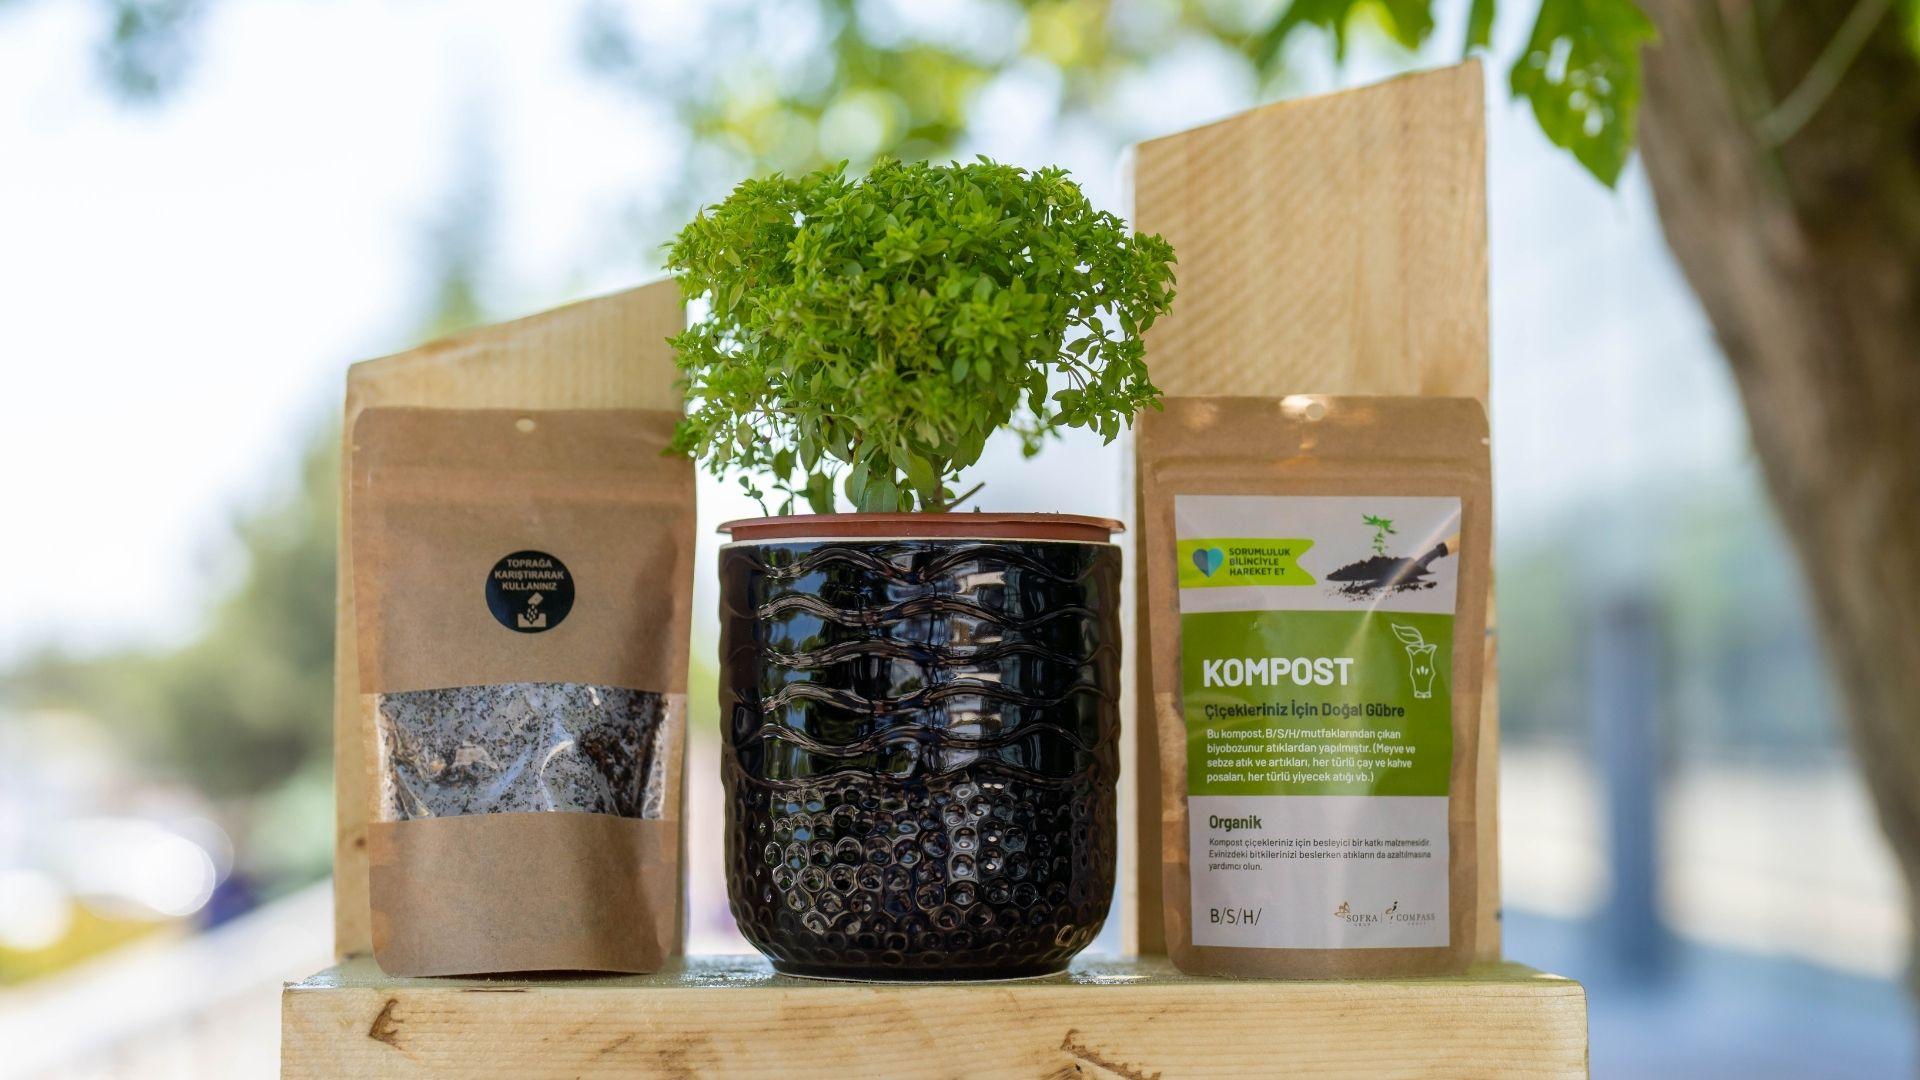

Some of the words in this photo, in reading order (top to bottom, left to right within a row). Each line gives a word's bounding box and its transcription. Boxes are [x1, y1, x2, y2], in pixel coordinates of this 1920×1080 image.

[1229, 548, 1290, 556] SORUMLULUK
[507, 558, 552, 568] TOPRAĞA
[1230, 556, 1279, 566] BİLİNCİYLE
[495, 571, 564, 581] KARIŞTIRARAK
[1230, 568, 1272, 576] HAREKET
[502, 582, 557, 590] KULLANINIZ
[1203, 657, 1354, 687] KOMPOST
[1205, 702, 1288, 720] Çiçekleriniz
[1291, 699, 1318, 718] İçin
[1322, 703, 1362, 719] Doğal
[1366, 703, 1404, 717] Gübre
[1207, 729, 1219, 738] Bu
[1377, 730, 1400, 740] çıkan
[1207, 744, 1264, 755] biyobozunur
[1266, 743, 1316, 752] atıklardan
[1207, 758, 1234, 767] sebze
[1236, 758, 1253, 767] atık
[1269, 757, 1310, 768] artıkları,
[1313, 757, 1329, 766] her
[1332, 757, 1354, 766] türlü
[1357, 759, 1373, 769] çay
[1388, 758, 1412, 768] kahve
[1207, 772, 1246, 783] posaları,
[1248, 772, 1264, 780] her
[1266, 772, 1290, 781] türlü
[1292, 772, 1330, 783] yiyecek
[1332, 772, 1354, 783] atığı
[1356, 771, 1374, 782] vb.)
[1209, 815, 1262, 832] Organik
[1209, 839, 1242, 847] Kompost
[1245, 838, 1293, 848] çiçekleriniz
[1295, 839, 1310, 848] için
[1313, 838, 1350, 848] besleyici
[1352, 838, 1362, 846] bir
[1364, 838, 1383, 846] katkı
[1385, 838, 1431, 846] malzemesidir.
[1209, 850, 1247, 858] Evinizdeki
[1250, 850, 1297, 858] bitkilerinizi
[1387, 850, 1431, 858] azaltılmasına
[1208, 862, 1240, 872] yardımcı
[1210, 907, 1262, 926] B/S/H/
[1346, 914, 1378, 923] SOFRA
[1396, 913, 1435, 921] COMPASS
